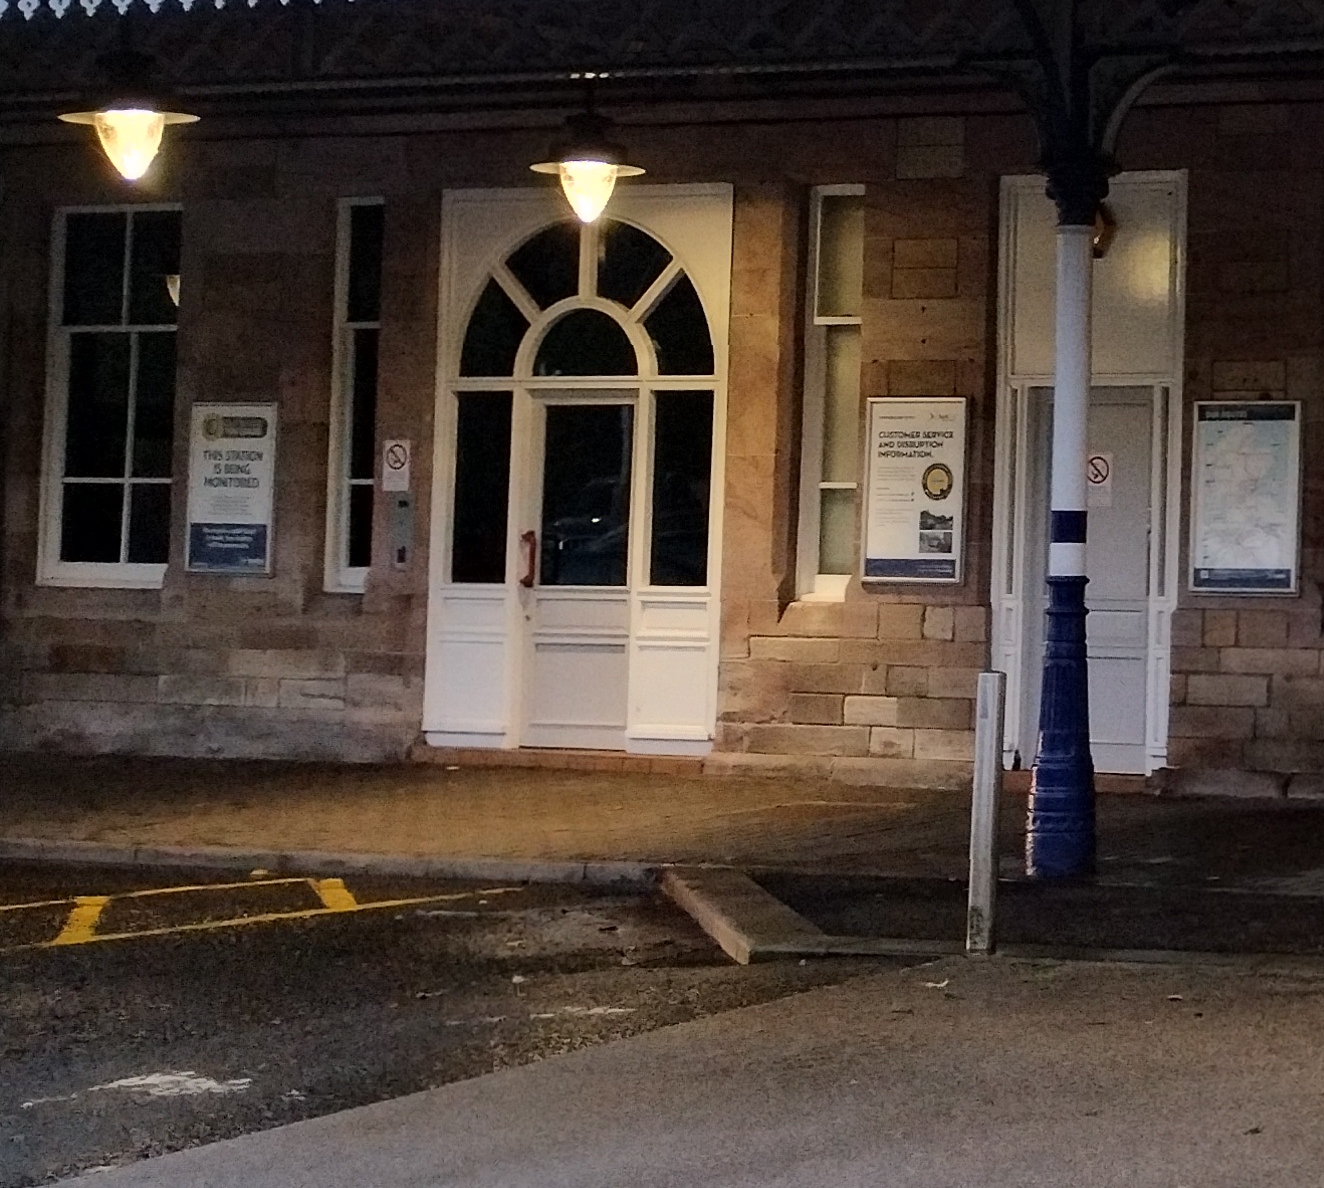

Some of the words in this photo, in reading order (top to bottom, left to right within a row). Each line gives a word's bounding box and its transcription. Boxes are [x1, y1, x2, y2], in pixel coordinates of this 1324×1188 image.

[879, 431, 920, 439] CUSTOMER
[923, 431, 953, 439] SERVICE
[898, 440, 943, 448] DISRUPTION
[203, 450, 223, 460] THIS
[225, 450, 263, 461] STATION
[214, 464, 221, 474] IS
[224, 463, 250, 474] BEING
[203, 477, 260, 488] MONITORED
